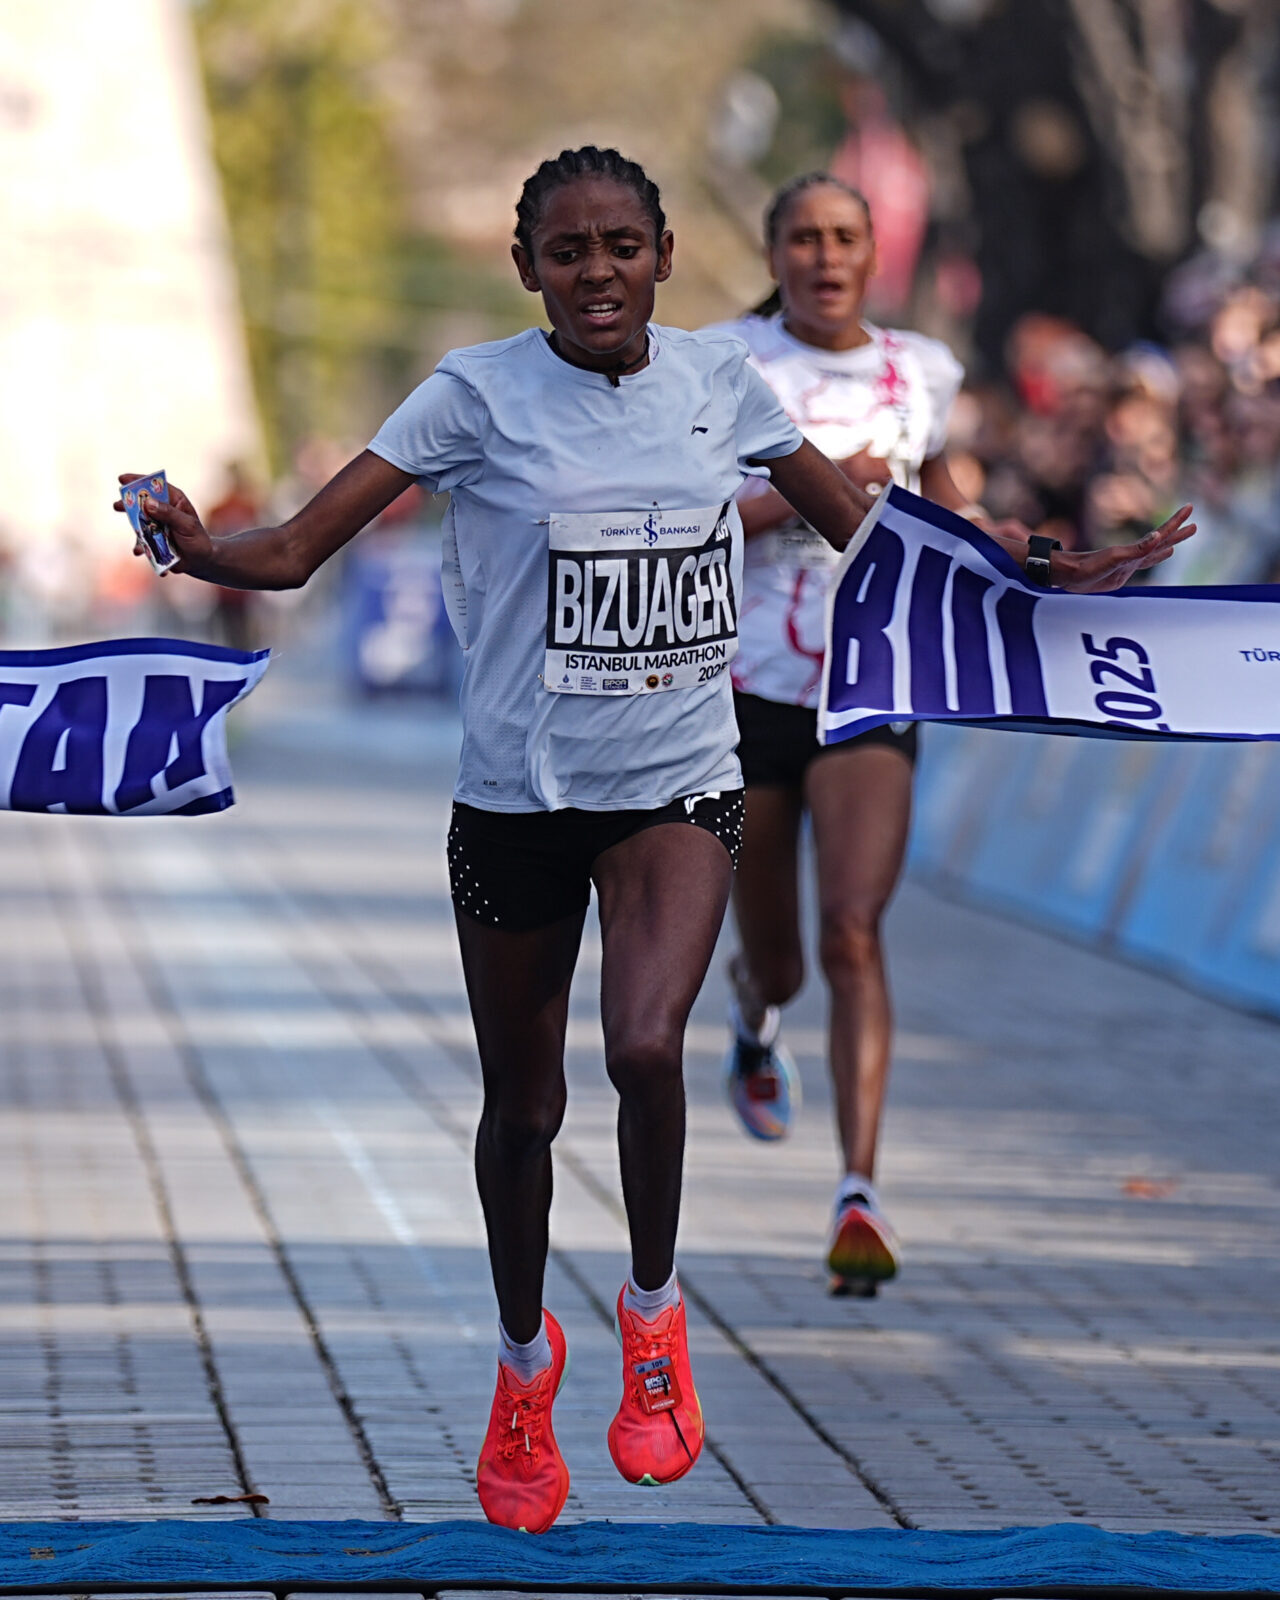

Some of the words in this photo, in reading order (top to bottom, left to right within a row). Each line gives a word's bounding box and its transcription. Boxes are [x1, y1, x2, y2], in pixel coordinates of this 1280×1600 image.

[600, 526, 642, 537] TÜRKİYE
[659, 525, 701, 535] BANKASI
[554, 548, 735, 647] BIZUAGER
[565, 653, 642, 672] ISTANBUL
[643, 643, 726, 671] MARATHON
